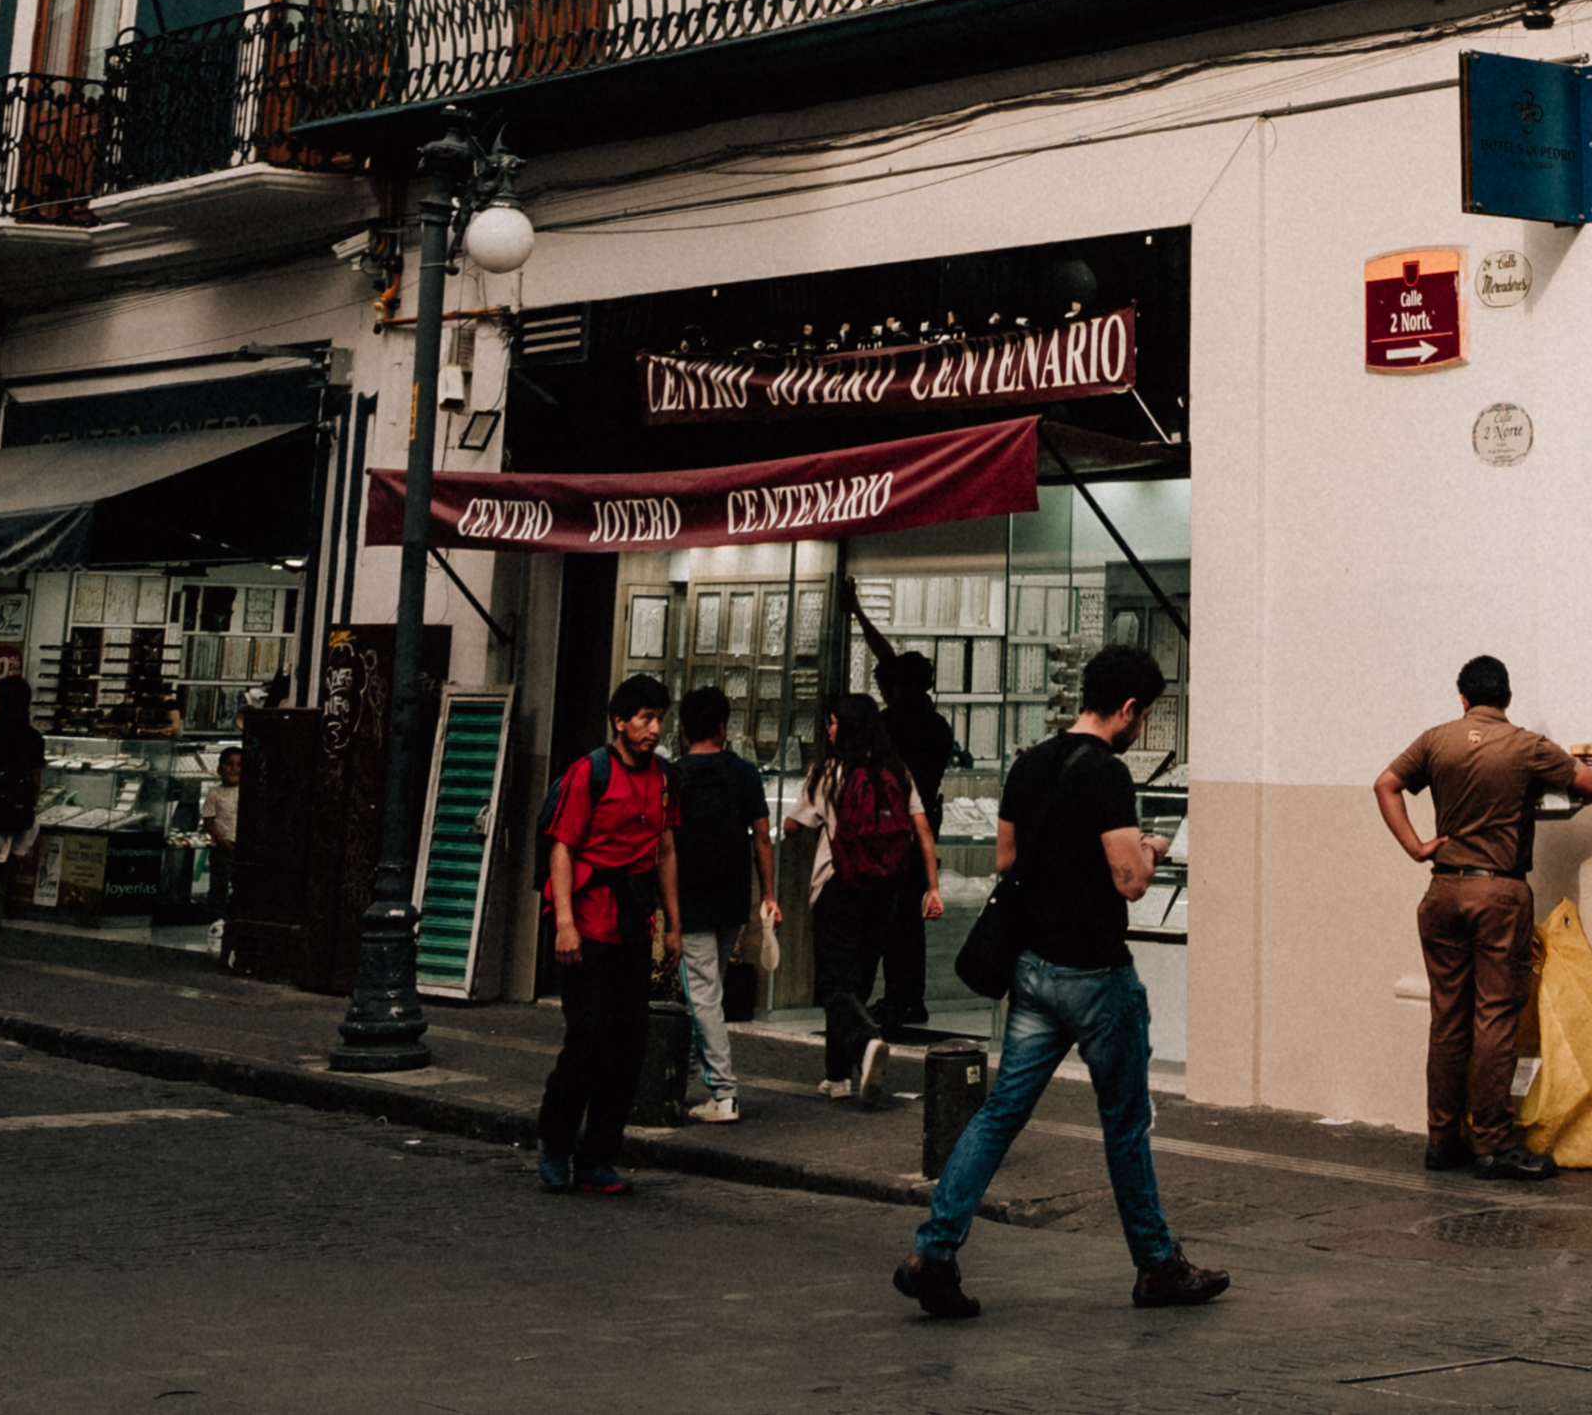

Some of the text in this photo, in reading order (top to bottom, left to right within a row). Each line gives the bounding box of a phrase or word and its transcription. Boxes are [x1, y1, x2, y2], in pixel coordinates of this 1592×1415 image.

[1540, 146, 1576, 162] PEDRO
[1400, 290, 1423, 307] Calle
[1389, 313, 1399, 333] 2
[646, 355, 756, 413] CENTRO
[909, 314, 1127, 402] CENTENARIO
[1483, 424, 1523, 441] 2 Norte
[457, 472, 895, 543] CENTRO JOYERO CENTENARIO
